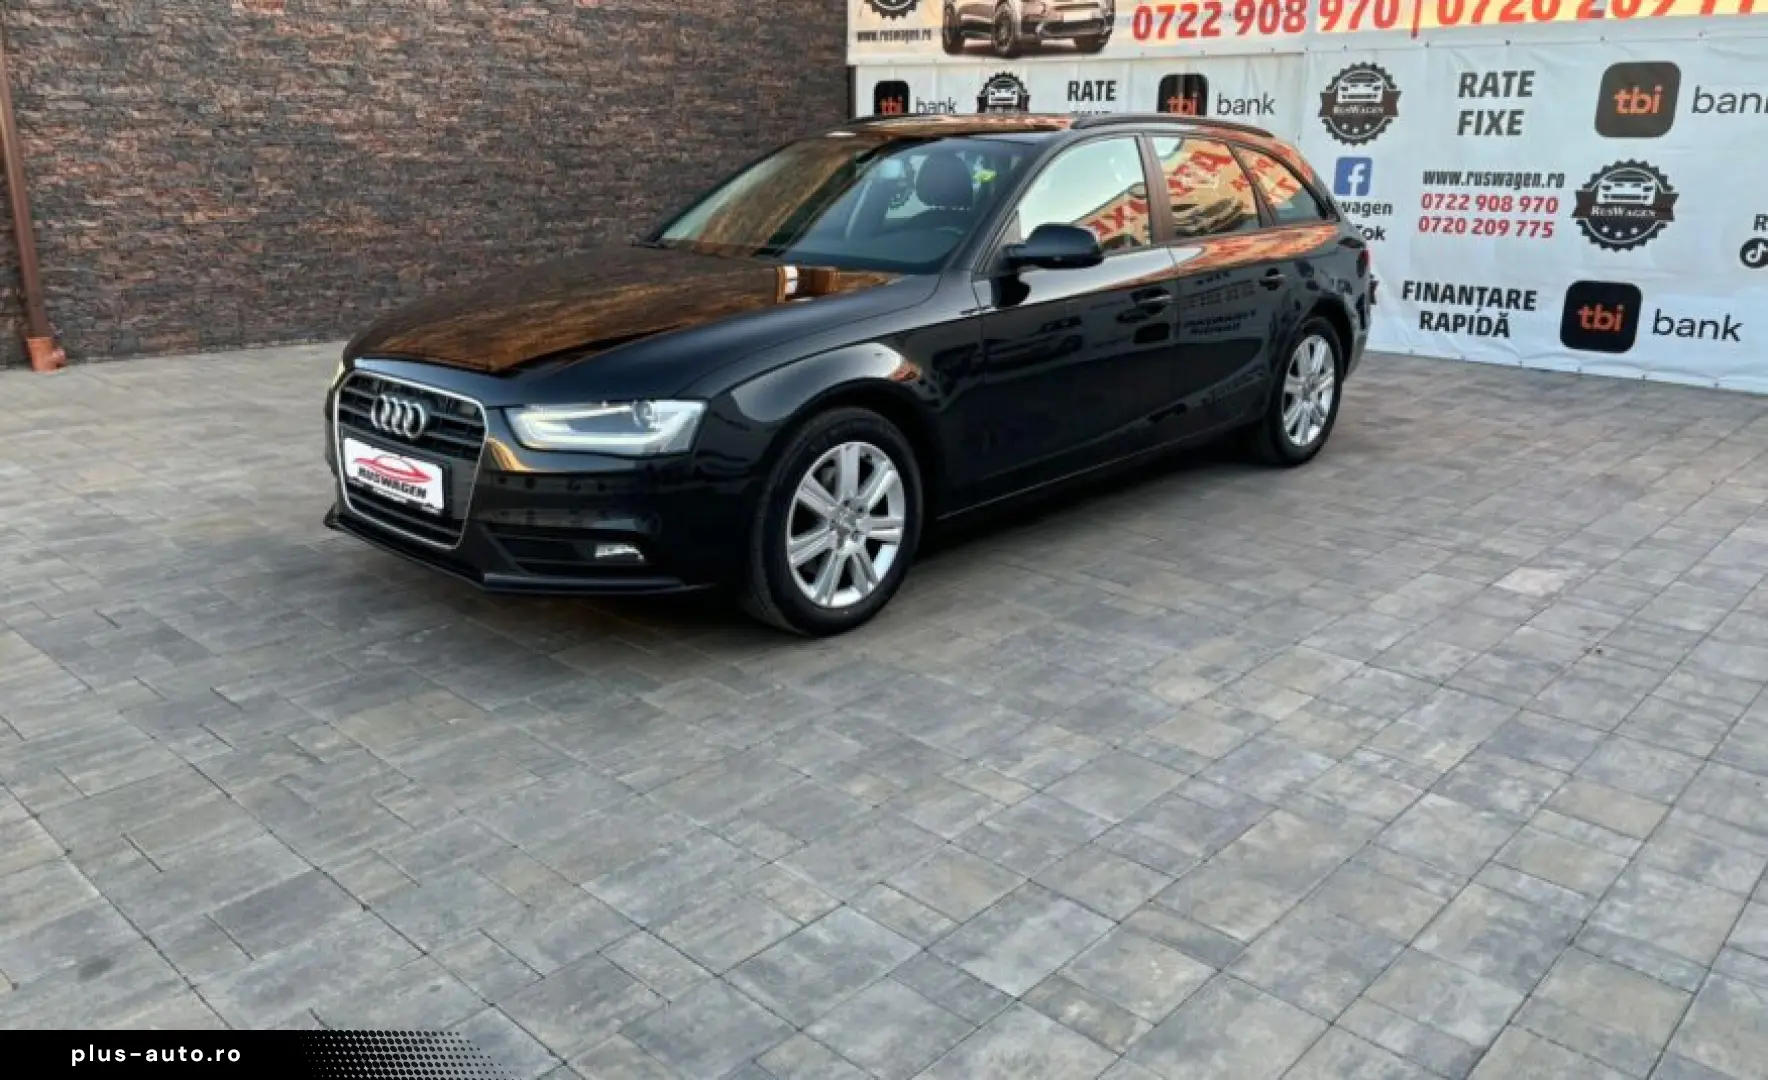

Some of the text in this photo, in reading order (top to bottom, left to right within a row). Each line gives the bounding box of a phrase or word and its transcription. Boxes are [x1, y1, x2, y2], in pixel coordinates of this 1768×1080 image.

[1133, 2, 1222, 41] 0722
[1233, 0, 1306, 36] 908
[1319, 0, 1399, 32] 970
[1067, 80, 1117, 102] RATE
[1458, 70, 1535, 98] RATE
[916, 96, 957, 114] bank
[1167, 92, 1276, 116] tbi bank
[1613, 84, 1768, 114] tbi ban
[1457, 109, 1525, 136] FIXE
[1422, 170, 1565, 190] www.ruswagen.ro
[1421, 193, 1559, 215] 0722 908 970
[1418, 215, 1555, 238] 0720 209 775
[1418, 310, 1511, 339] RAPIDĂ
[1577, 304, 1744, 343] tbi bank
